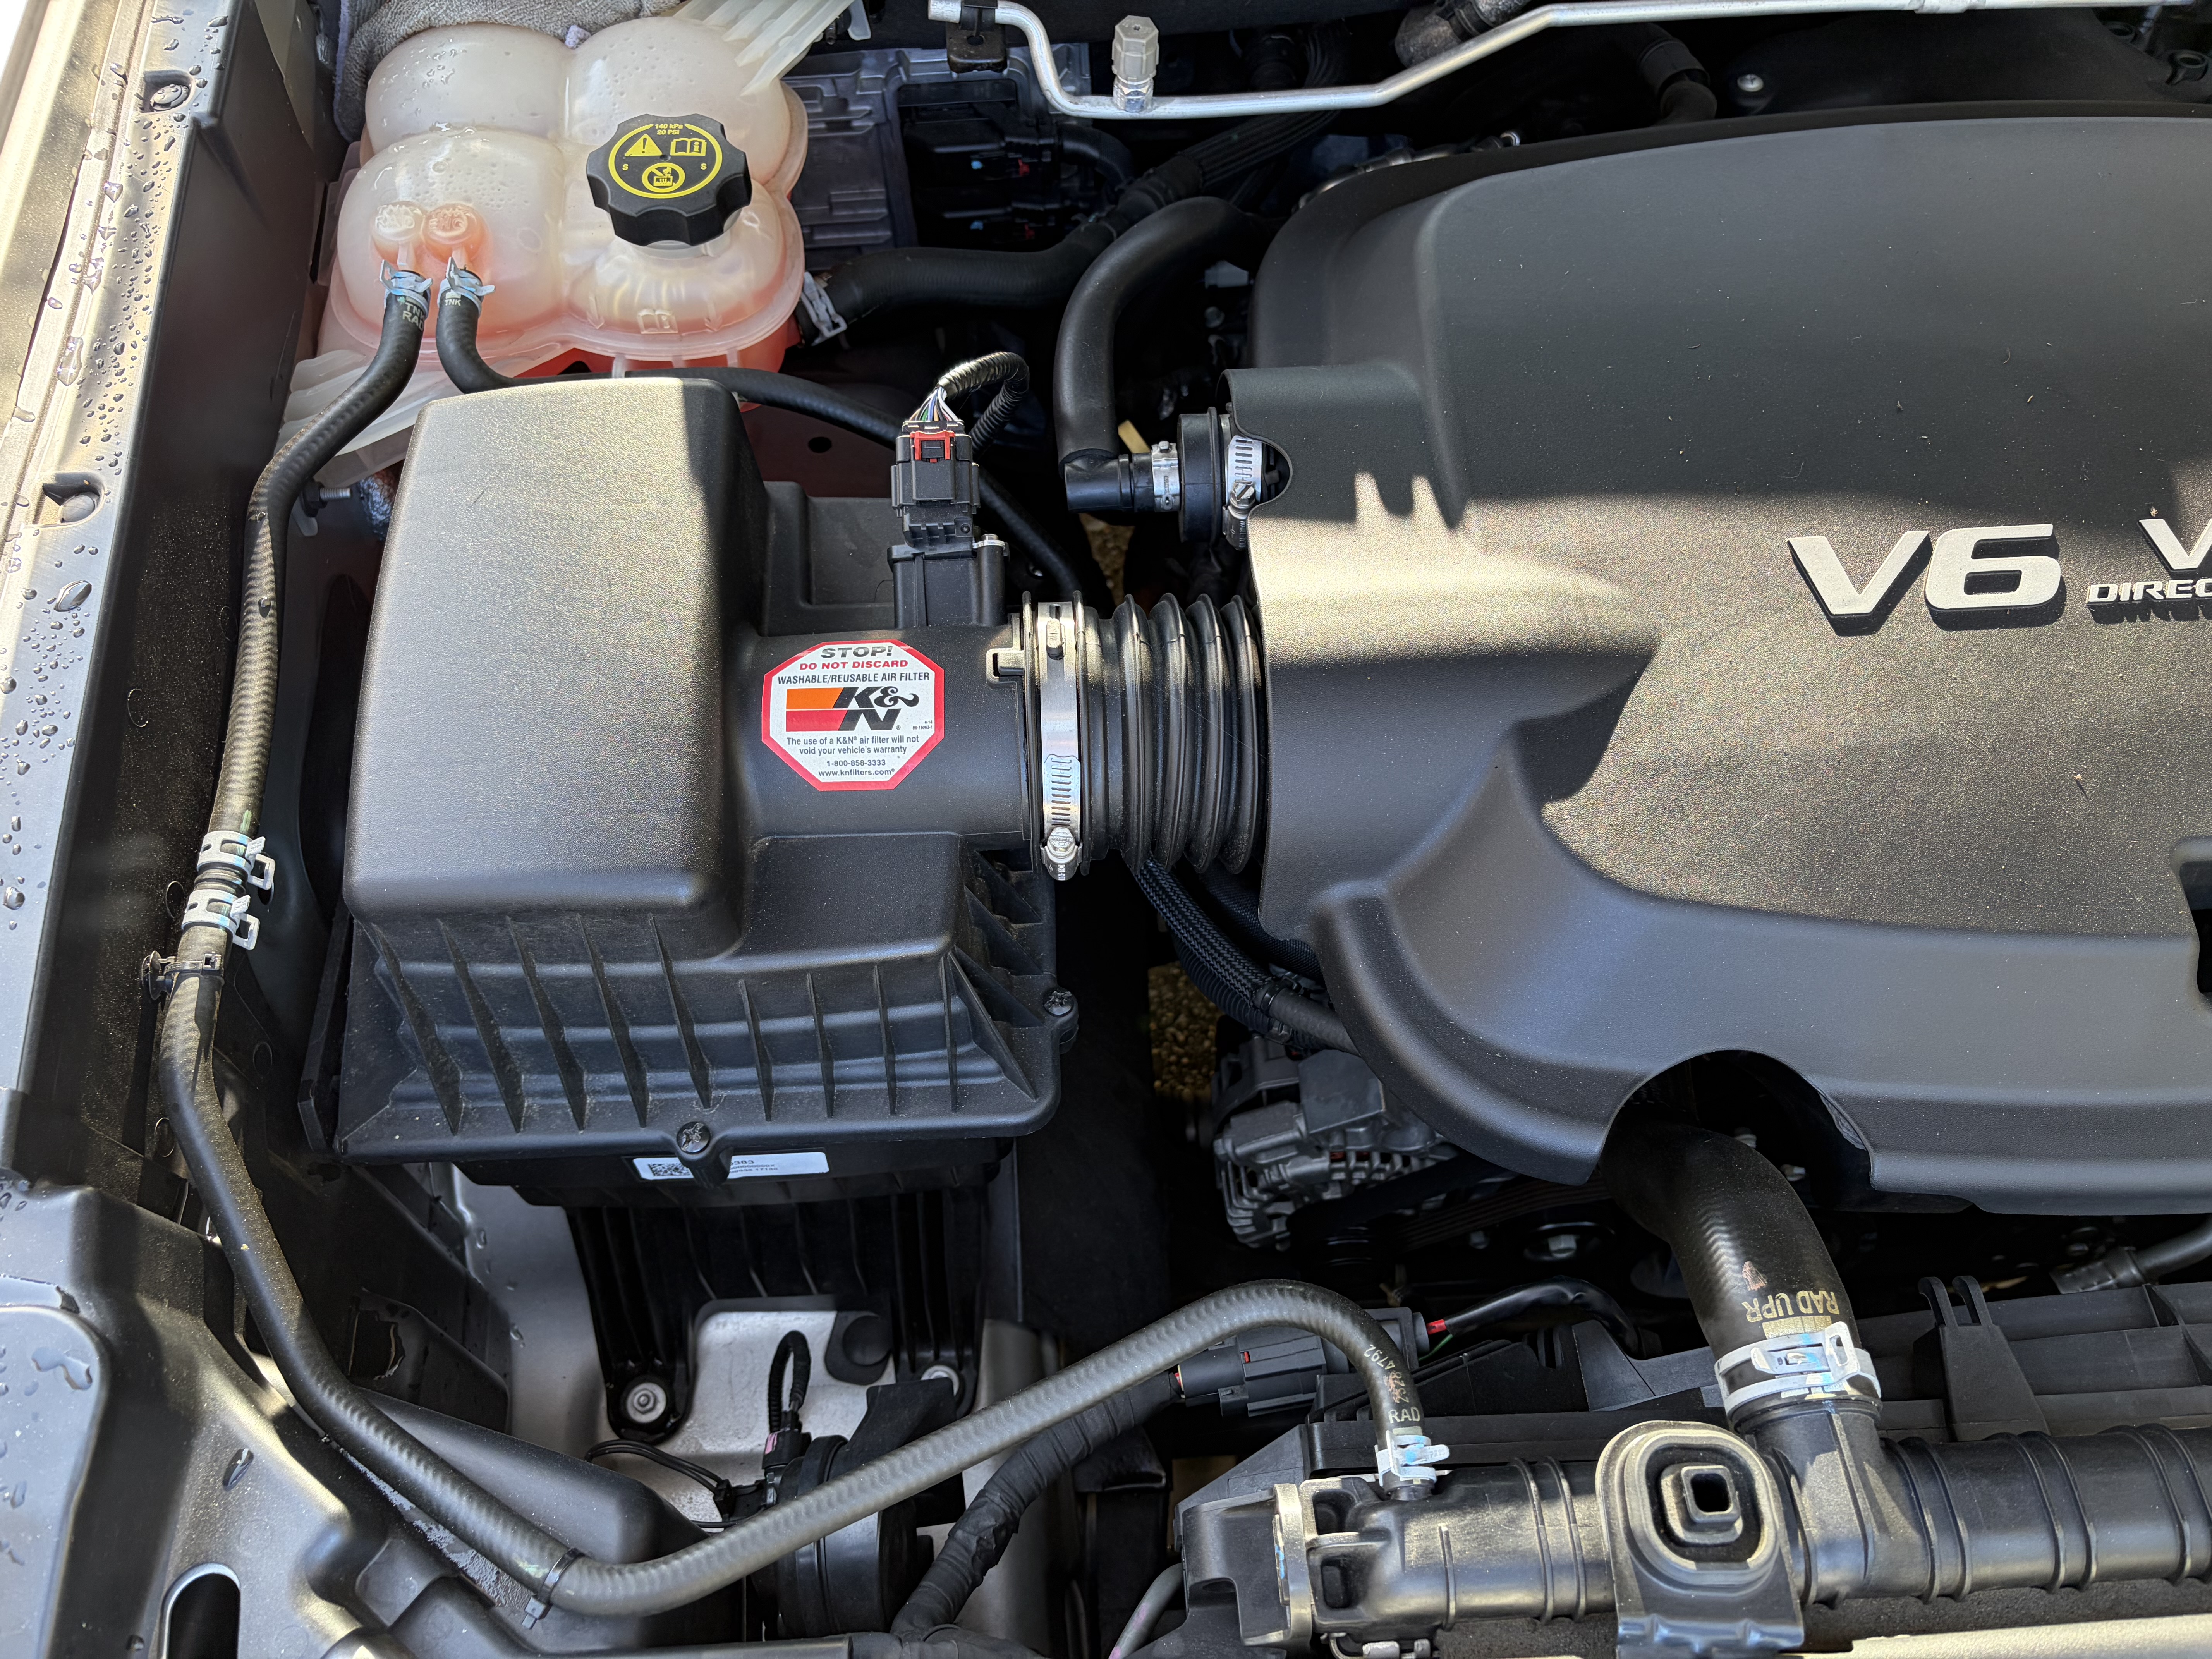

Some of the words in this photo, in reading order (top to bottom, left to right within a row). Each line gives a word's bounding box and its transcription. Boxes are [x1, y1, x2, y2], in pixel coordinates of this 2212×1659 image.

[1787, 524, 2061, 616] V6
[821, 646, 893, 658] STOP!
[821, 661, 848, 670] NOT
[852, 660, 908, 668] DISCARD
[778, 673, 879, 684] WASHABLE/REUSABLE
[881, 673, 896, 682] AIR
[900, 672, 930, 681] FILTER
[786, 737, 801, 745] The
[819, 737, 827, 745] of
[859, 736, 869, 744] air
[871, 735, 889, 744] filter
[891, 735, 904, 743] will
[799, 746, 816, 754] void
[817, 748, 836, 756] your
[837, 745, 871, 754] vehicle's
[873, 745, 907, 755] warranty
[1741, 1293, 1794, 1323] UPR
[1796, 1290, 1840, 1315] RAD
[1364, 1344, 1396, 1370] 4792
[1388, 1406, 1420, 1424] RAD
